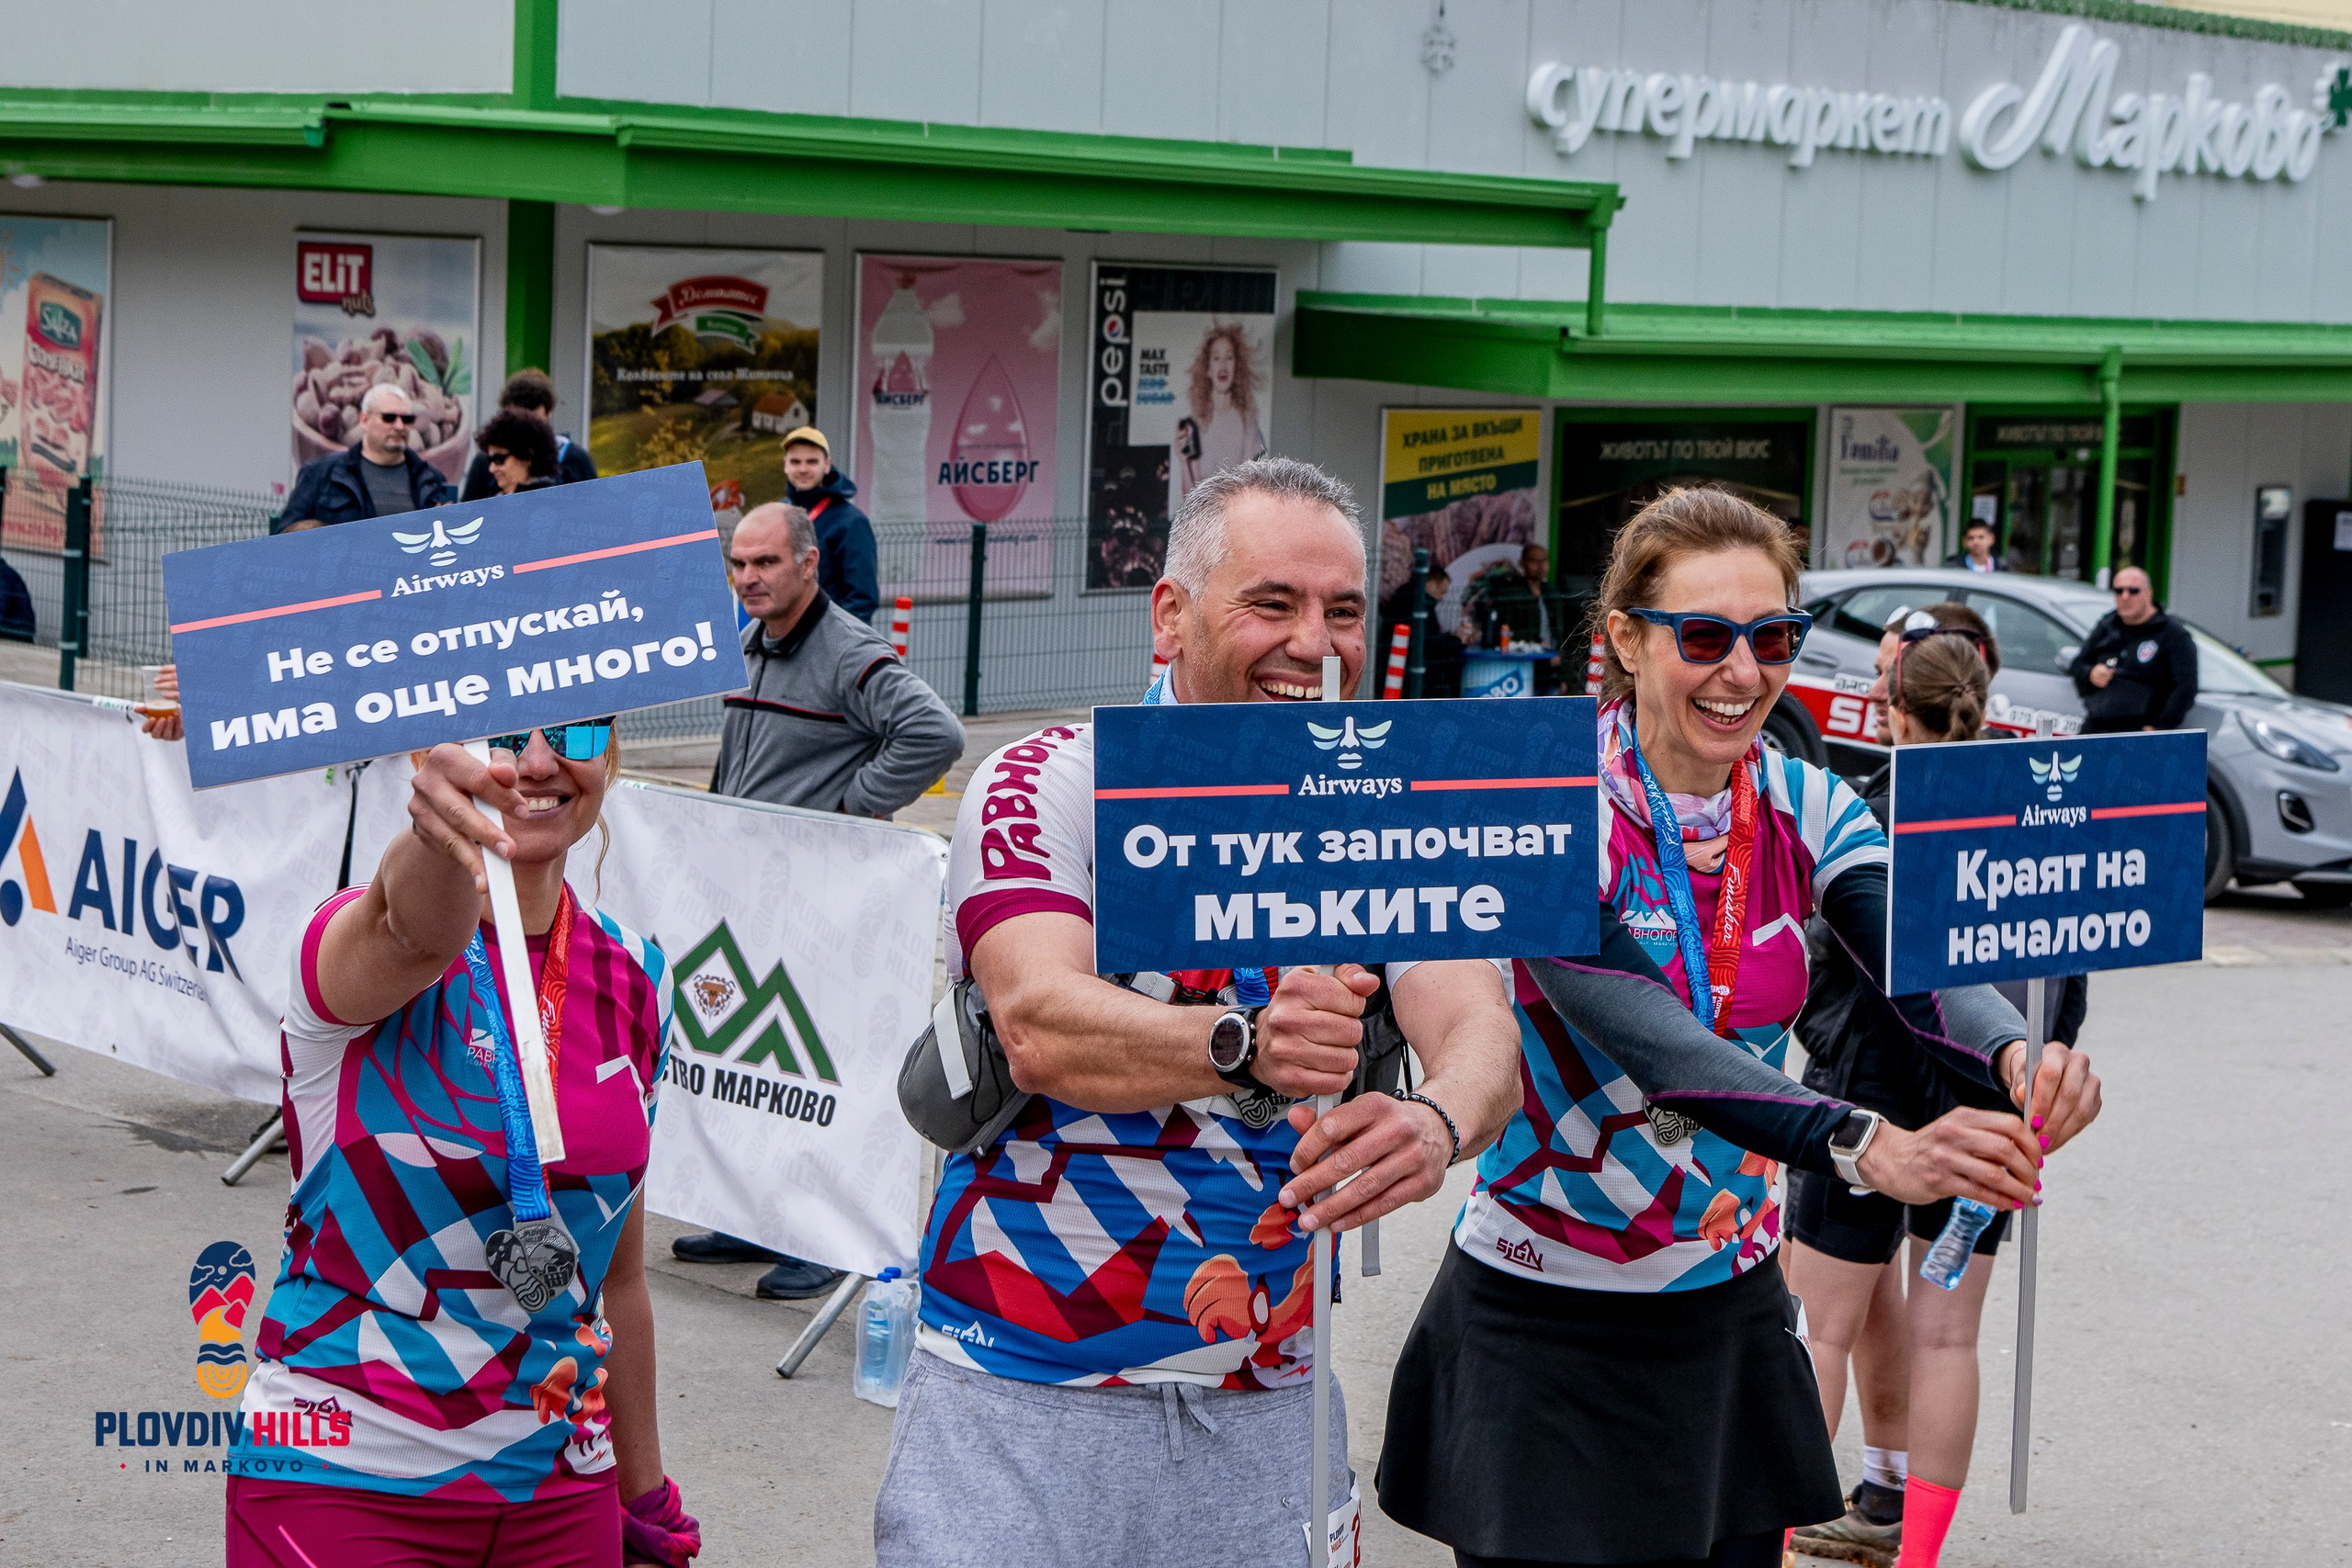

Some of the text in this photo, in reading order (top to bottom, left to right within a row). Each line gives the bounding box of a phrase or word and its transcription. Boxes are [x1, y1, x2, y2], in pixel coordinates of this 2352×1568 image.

[1959, 23, 2325, 202] Марково
[1100, 277, 1131, 407] pepsi
[1140, 349, 1166, 361] MAX
[1139, 363, 1170, 376] TASTE
[1402, 417, 1522, 449] ХРАНА ЗА ВКЪЩИ
[1671, 439, 1694, 459] ПО
[1697, 436, 1734, 459] ТВОЙ
[938, 457, 1040, 485] АЙСБЕРГ
[1419, 446, 1504, 473] ПРИГОТВЕНА
[1427, 473, 1498, 501] НА МЯСТО
[390, 563, 505, 598] Airways
[266, 589, 645, 682] Не се отпускай,
[209, 621, 718, 751] има още много!
[1297, 773, 1403, 799] Airways
[2021, 804, 2086, 828] Airways
[1123, 824, 1572, 876] От тук започват
[1956, 849, 2146, 911] Краят на
[67, 828, 245, 985] AIGER
[1194, 885, 1505, 942] мъките
[1948, 908, 2151, 965] началото
[65, 937, 97, 964] Aiger
[100, 947, 137, 979] Group
[140, 959, 156, 982] AG
[712, 1067, 837, 1128] МАРКОВО
